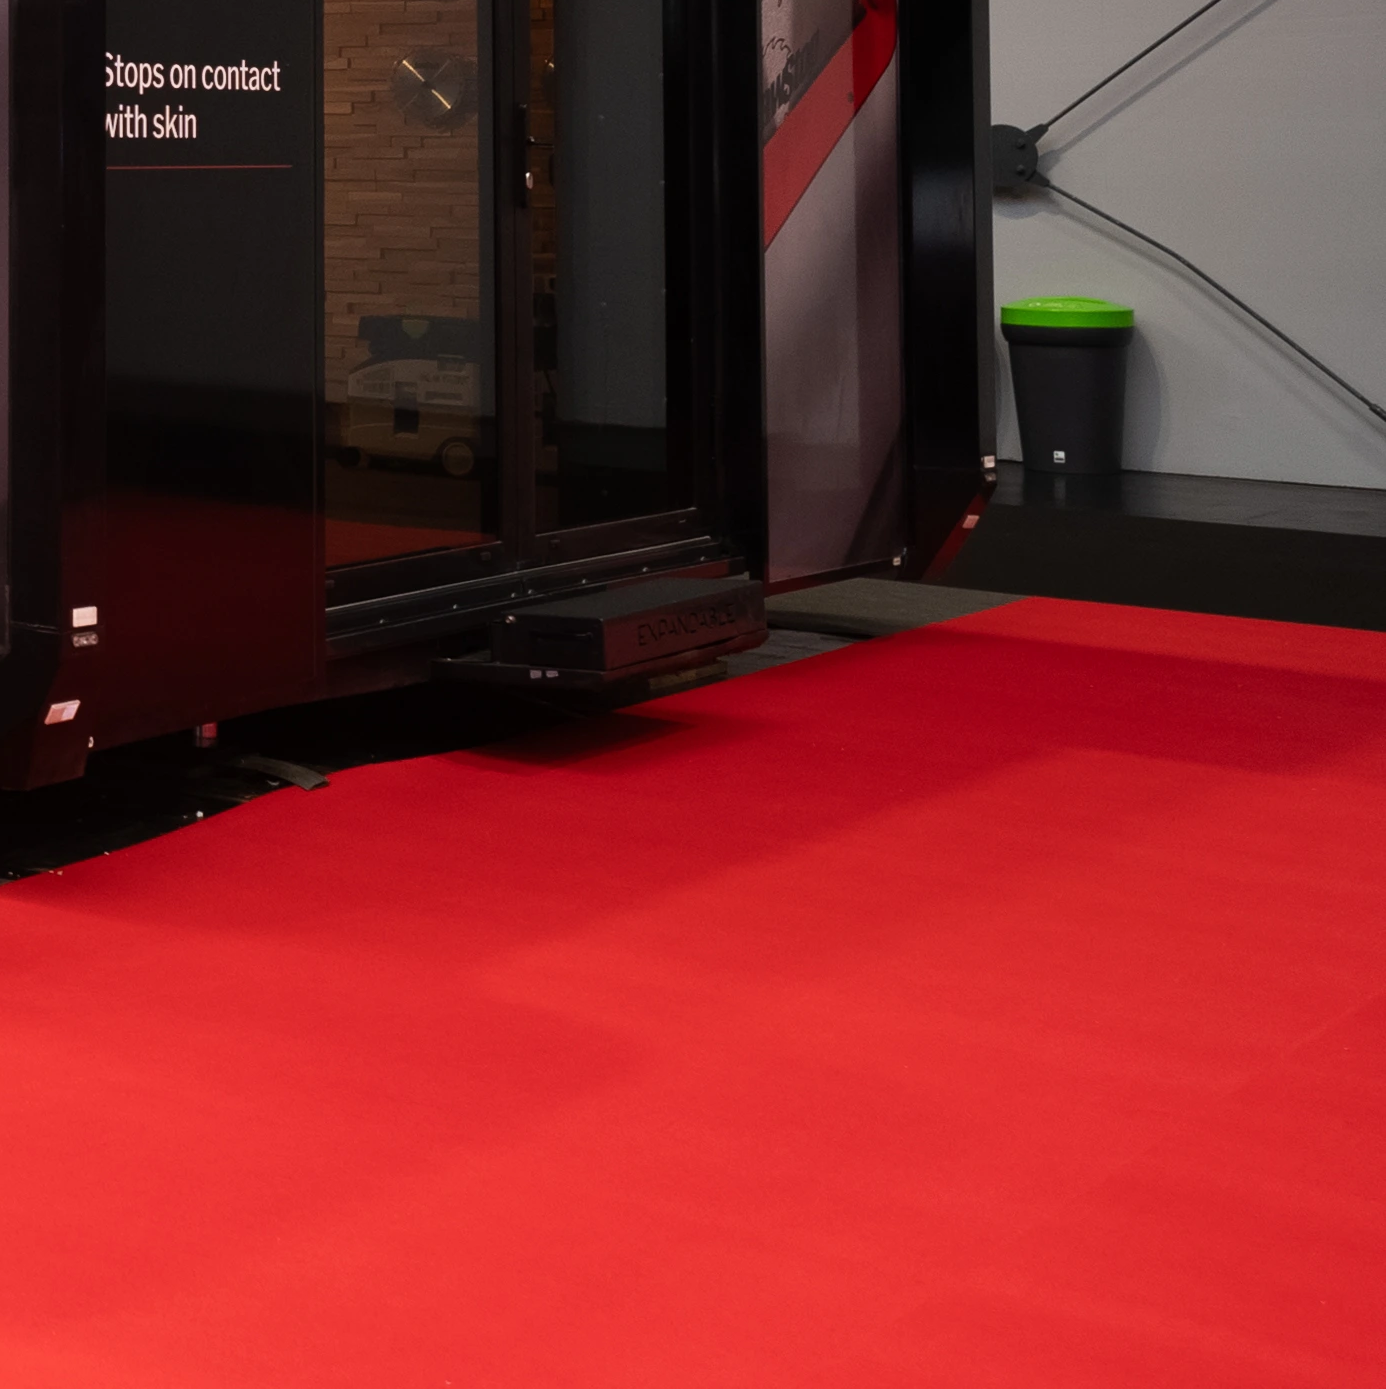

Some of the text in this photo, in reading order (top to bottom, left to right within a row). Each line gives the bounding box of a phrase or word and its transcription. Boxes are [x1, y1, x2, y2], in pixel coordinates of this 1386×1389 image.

[170, 63, 196, 89] on
[201, 59, 281, 91] contact
[105, 103, 197, 139] with skin
